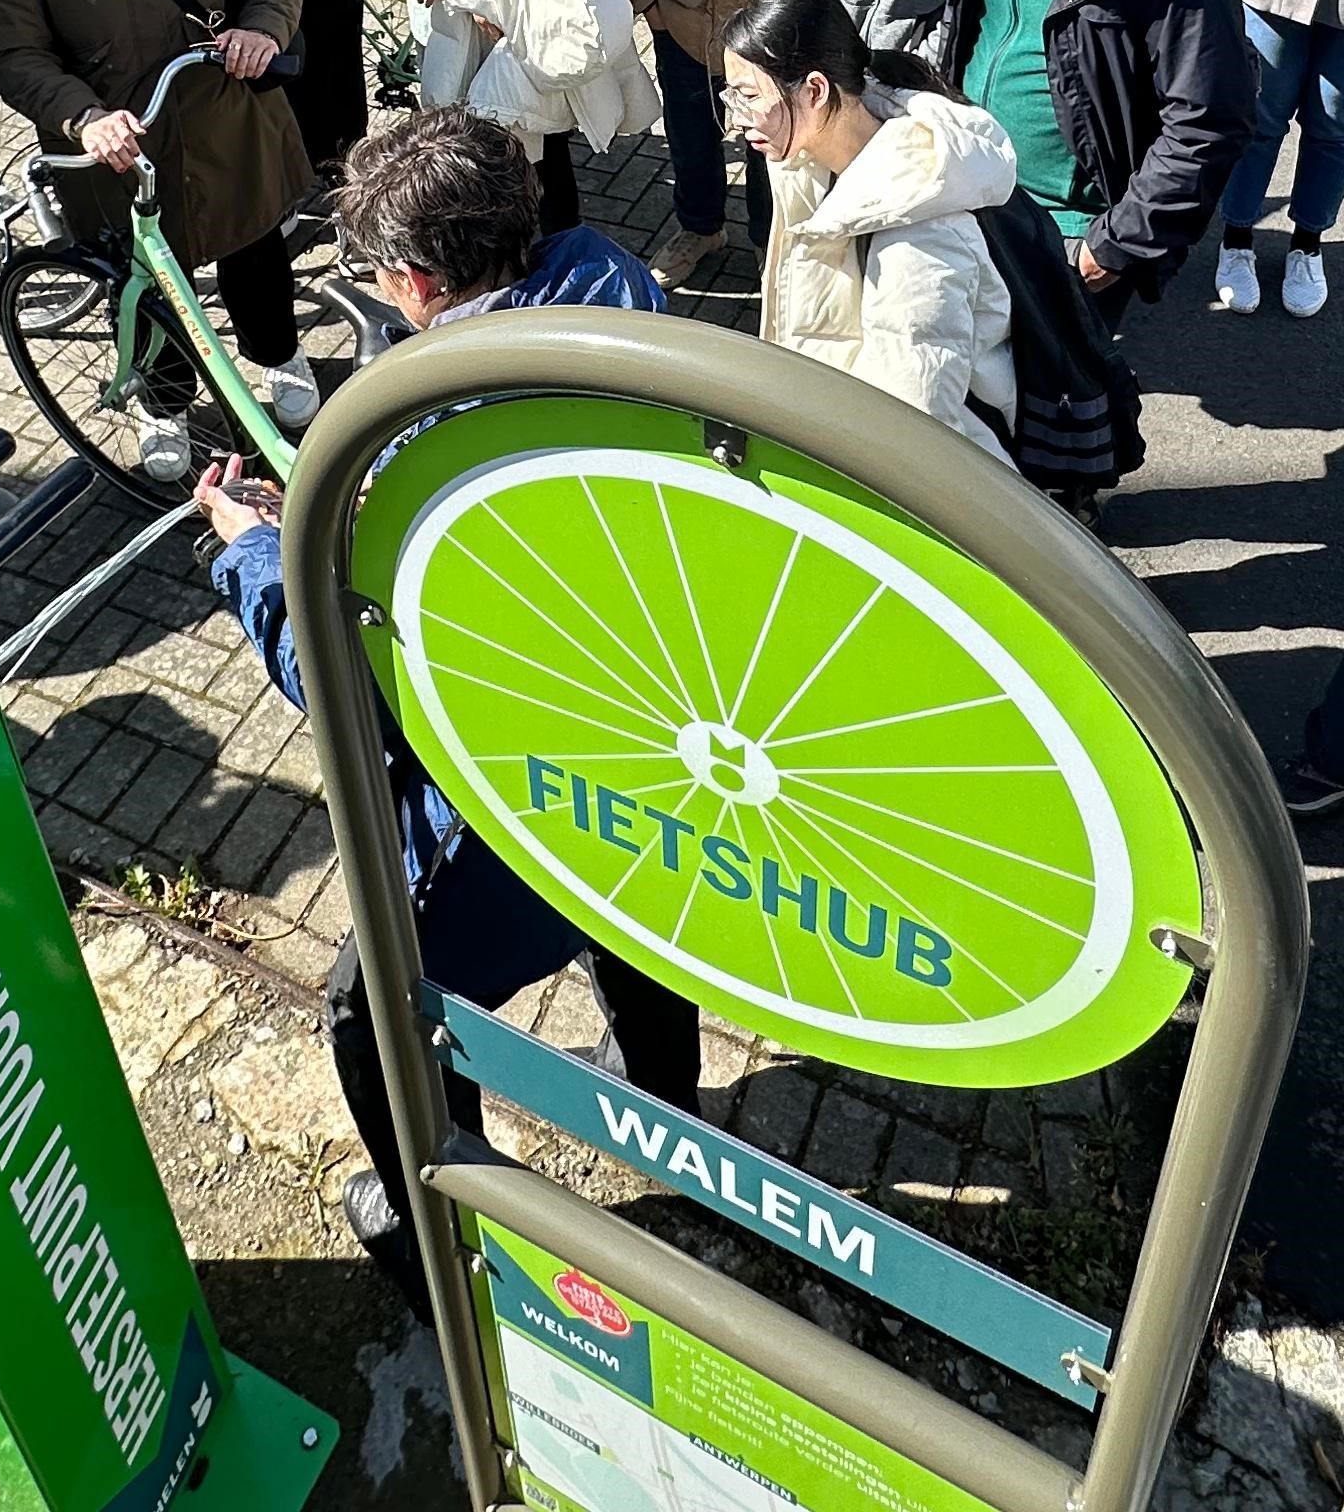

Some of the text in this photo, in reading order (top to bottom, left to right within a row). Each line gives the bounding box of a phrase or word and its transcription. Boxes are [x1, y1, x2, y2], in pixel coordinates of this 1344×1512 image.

[526, 755, 954, 988] FIETSHUB
[596, 1092, 876, 1276] WALEM
[9, 1124, 166, 1467] HERSTELPUNT
[520, 1301, 621, 1373] WELKOM
[661, 1327, 697, 1355] Hier
[701, 1354, 731, 1377] kan
[510, 1392, 596, 1452] WILLEBROEK
[711, 1369, 775, 1416] banden
[692, 1436, 793, 1503] ANTWERPEN
[711, 1395, 790, 1448] fietsroute
[794, 1444, 851, 1483] verder
[724, 1390, 777, 1428] kleine
[781, 1424, 901, 1501] herstellingen
